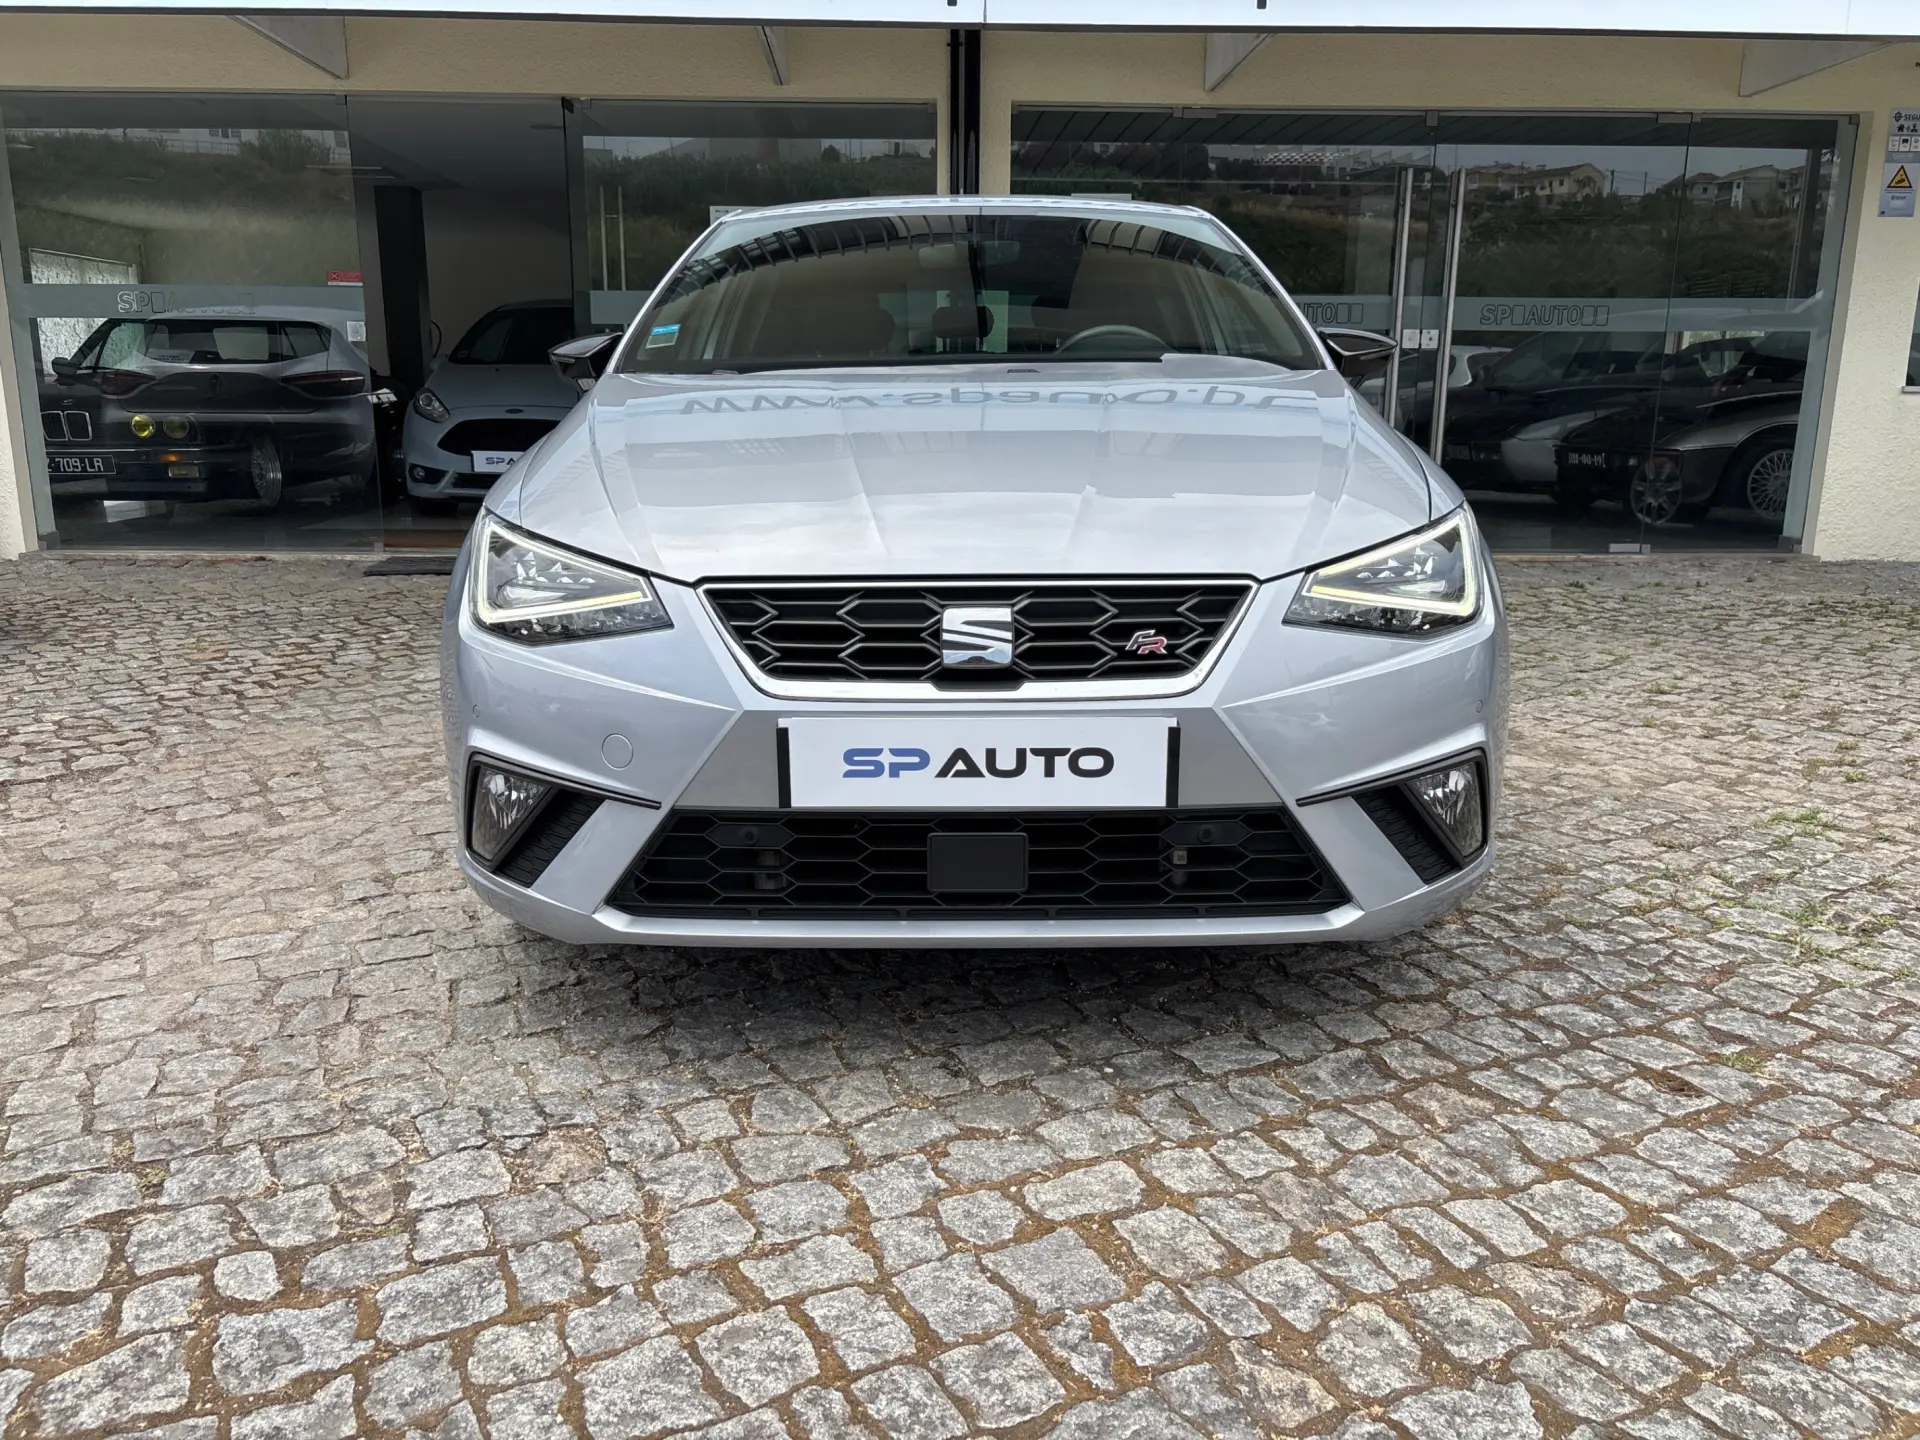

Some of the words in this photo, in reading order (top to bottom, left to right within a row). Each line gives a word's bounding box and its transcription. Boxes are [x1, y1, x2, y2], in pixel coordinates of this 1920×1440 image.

[1295, 302, 1336, 324] UTO
[1125, 629, 1168, 655] FR
[842, 747, 931, 779] SP
[934, 746, 1115, 779] AUTO
